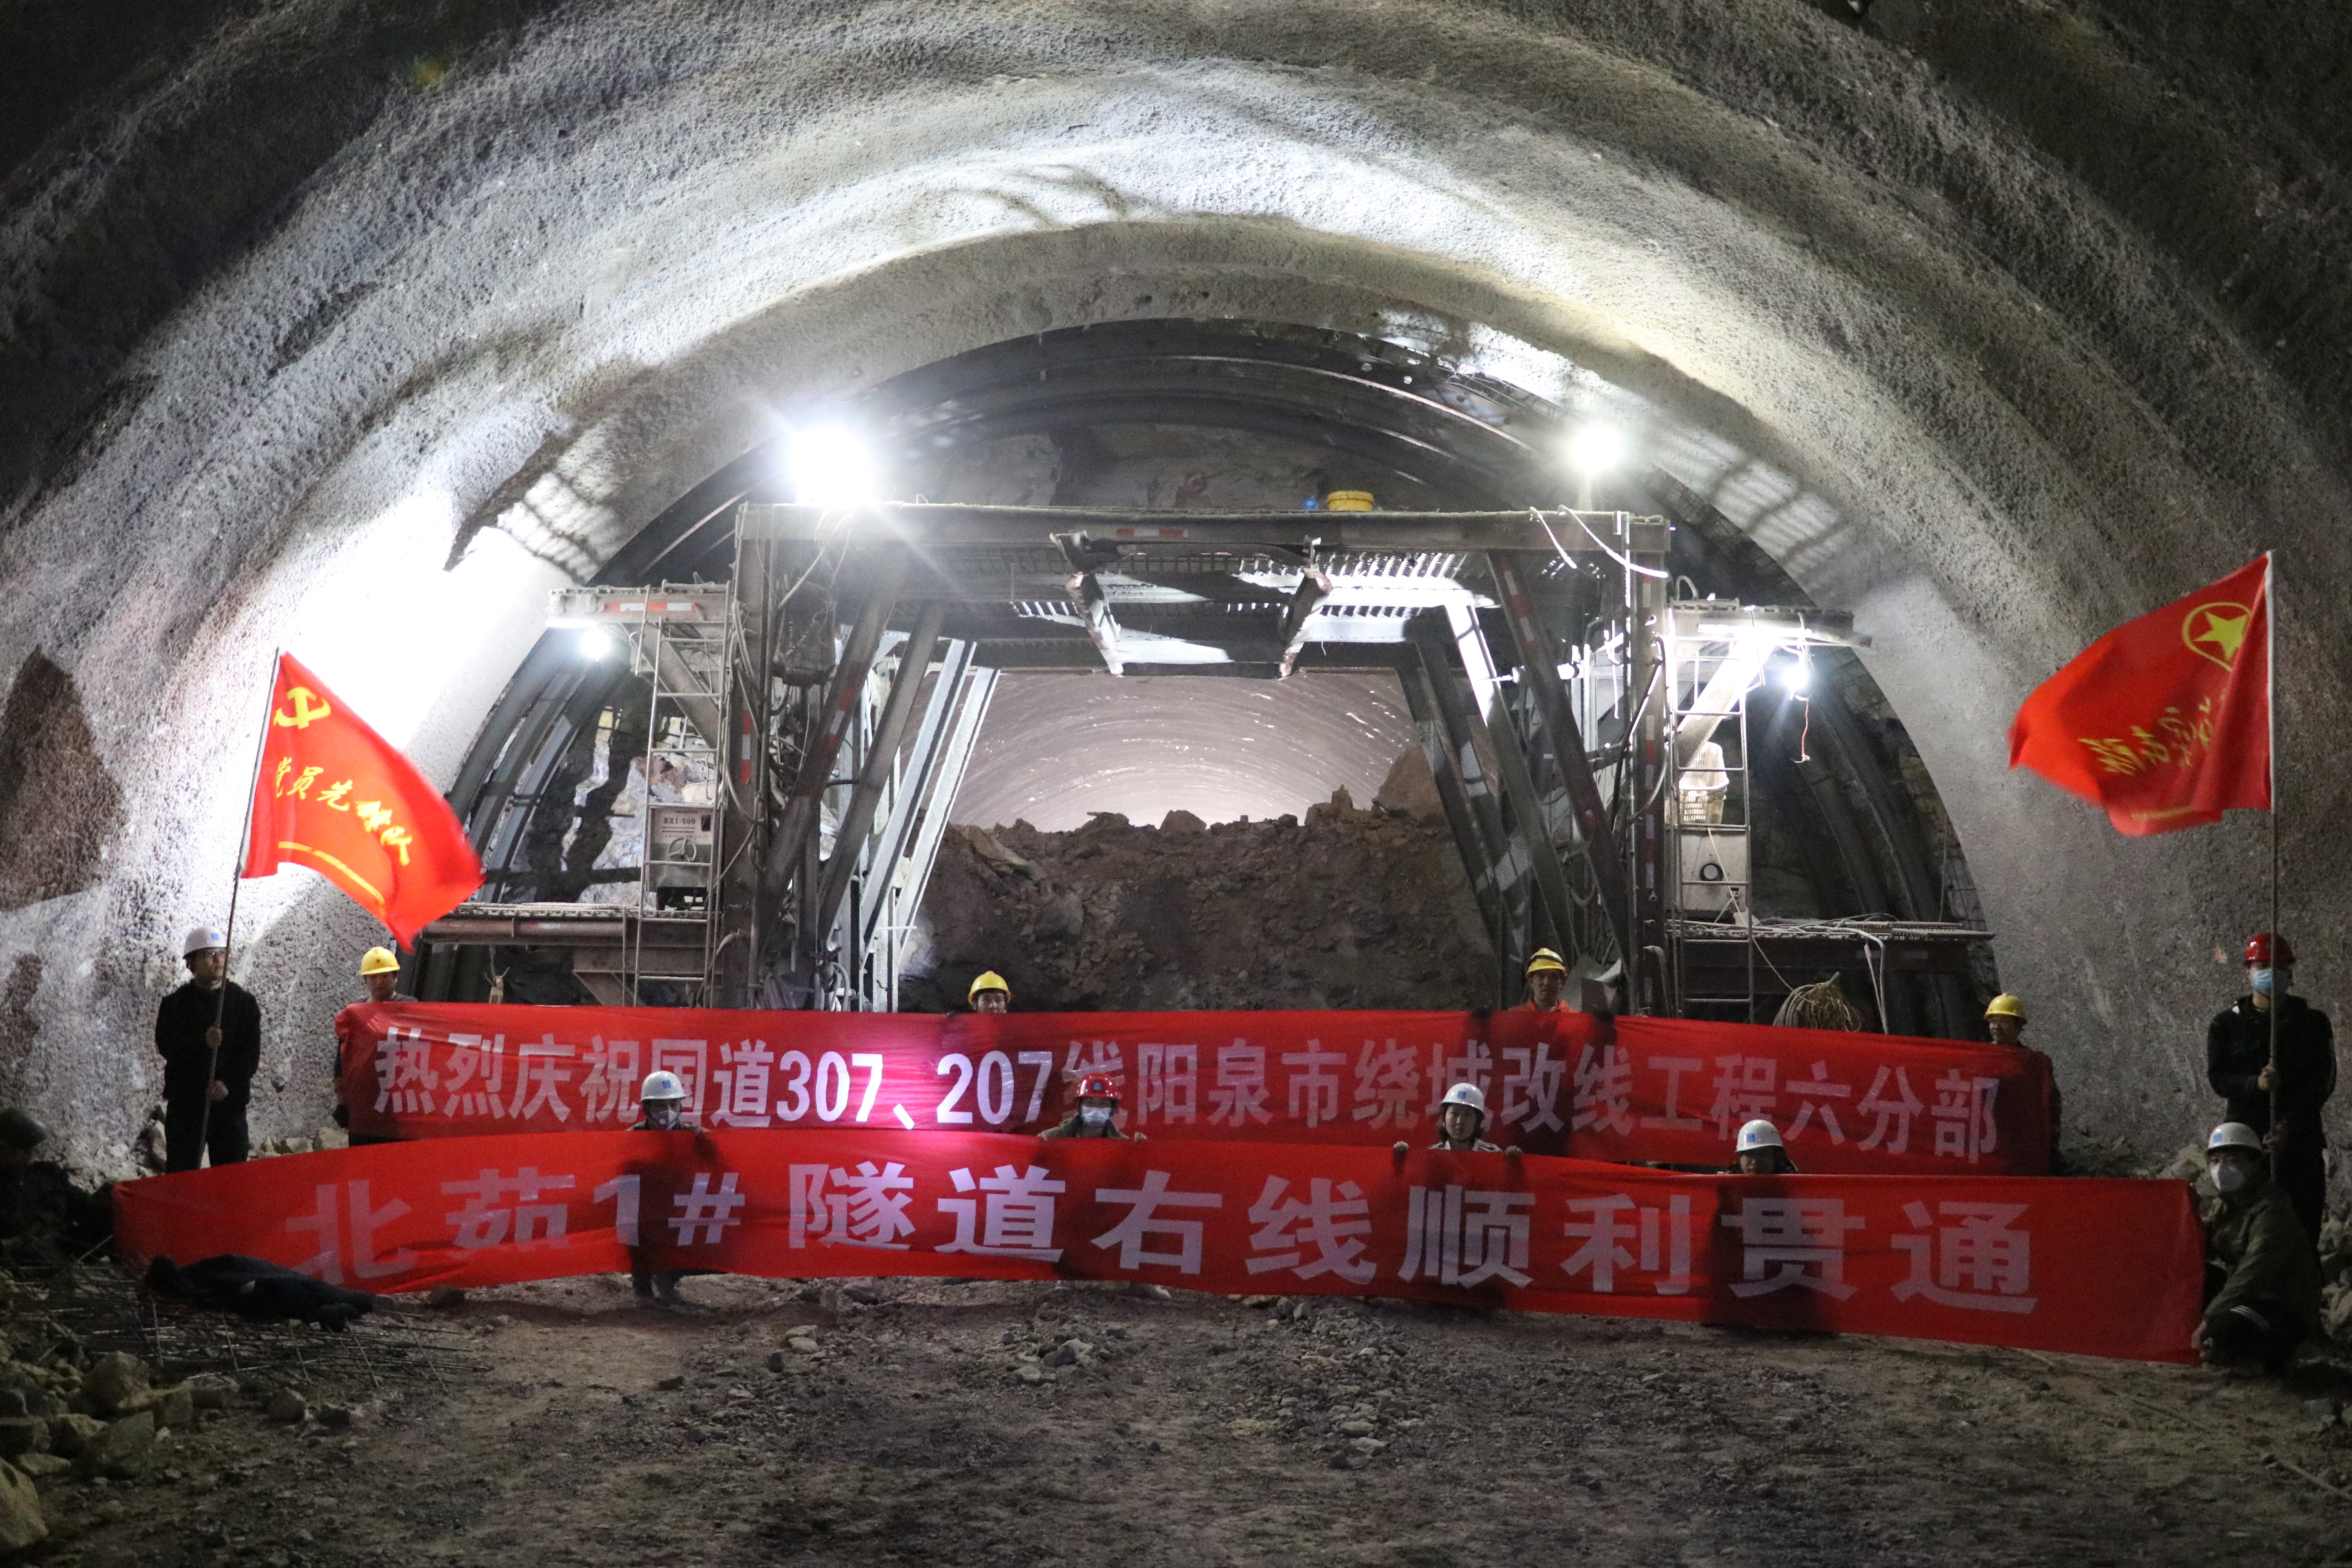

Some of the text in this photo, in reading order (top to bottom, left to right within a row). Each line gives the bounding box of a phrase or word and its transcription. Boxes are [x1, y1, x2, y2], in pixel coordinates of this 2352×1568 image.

[285, 1160, 2038, 1315] 北茹1#隧道右线顺利贯通
